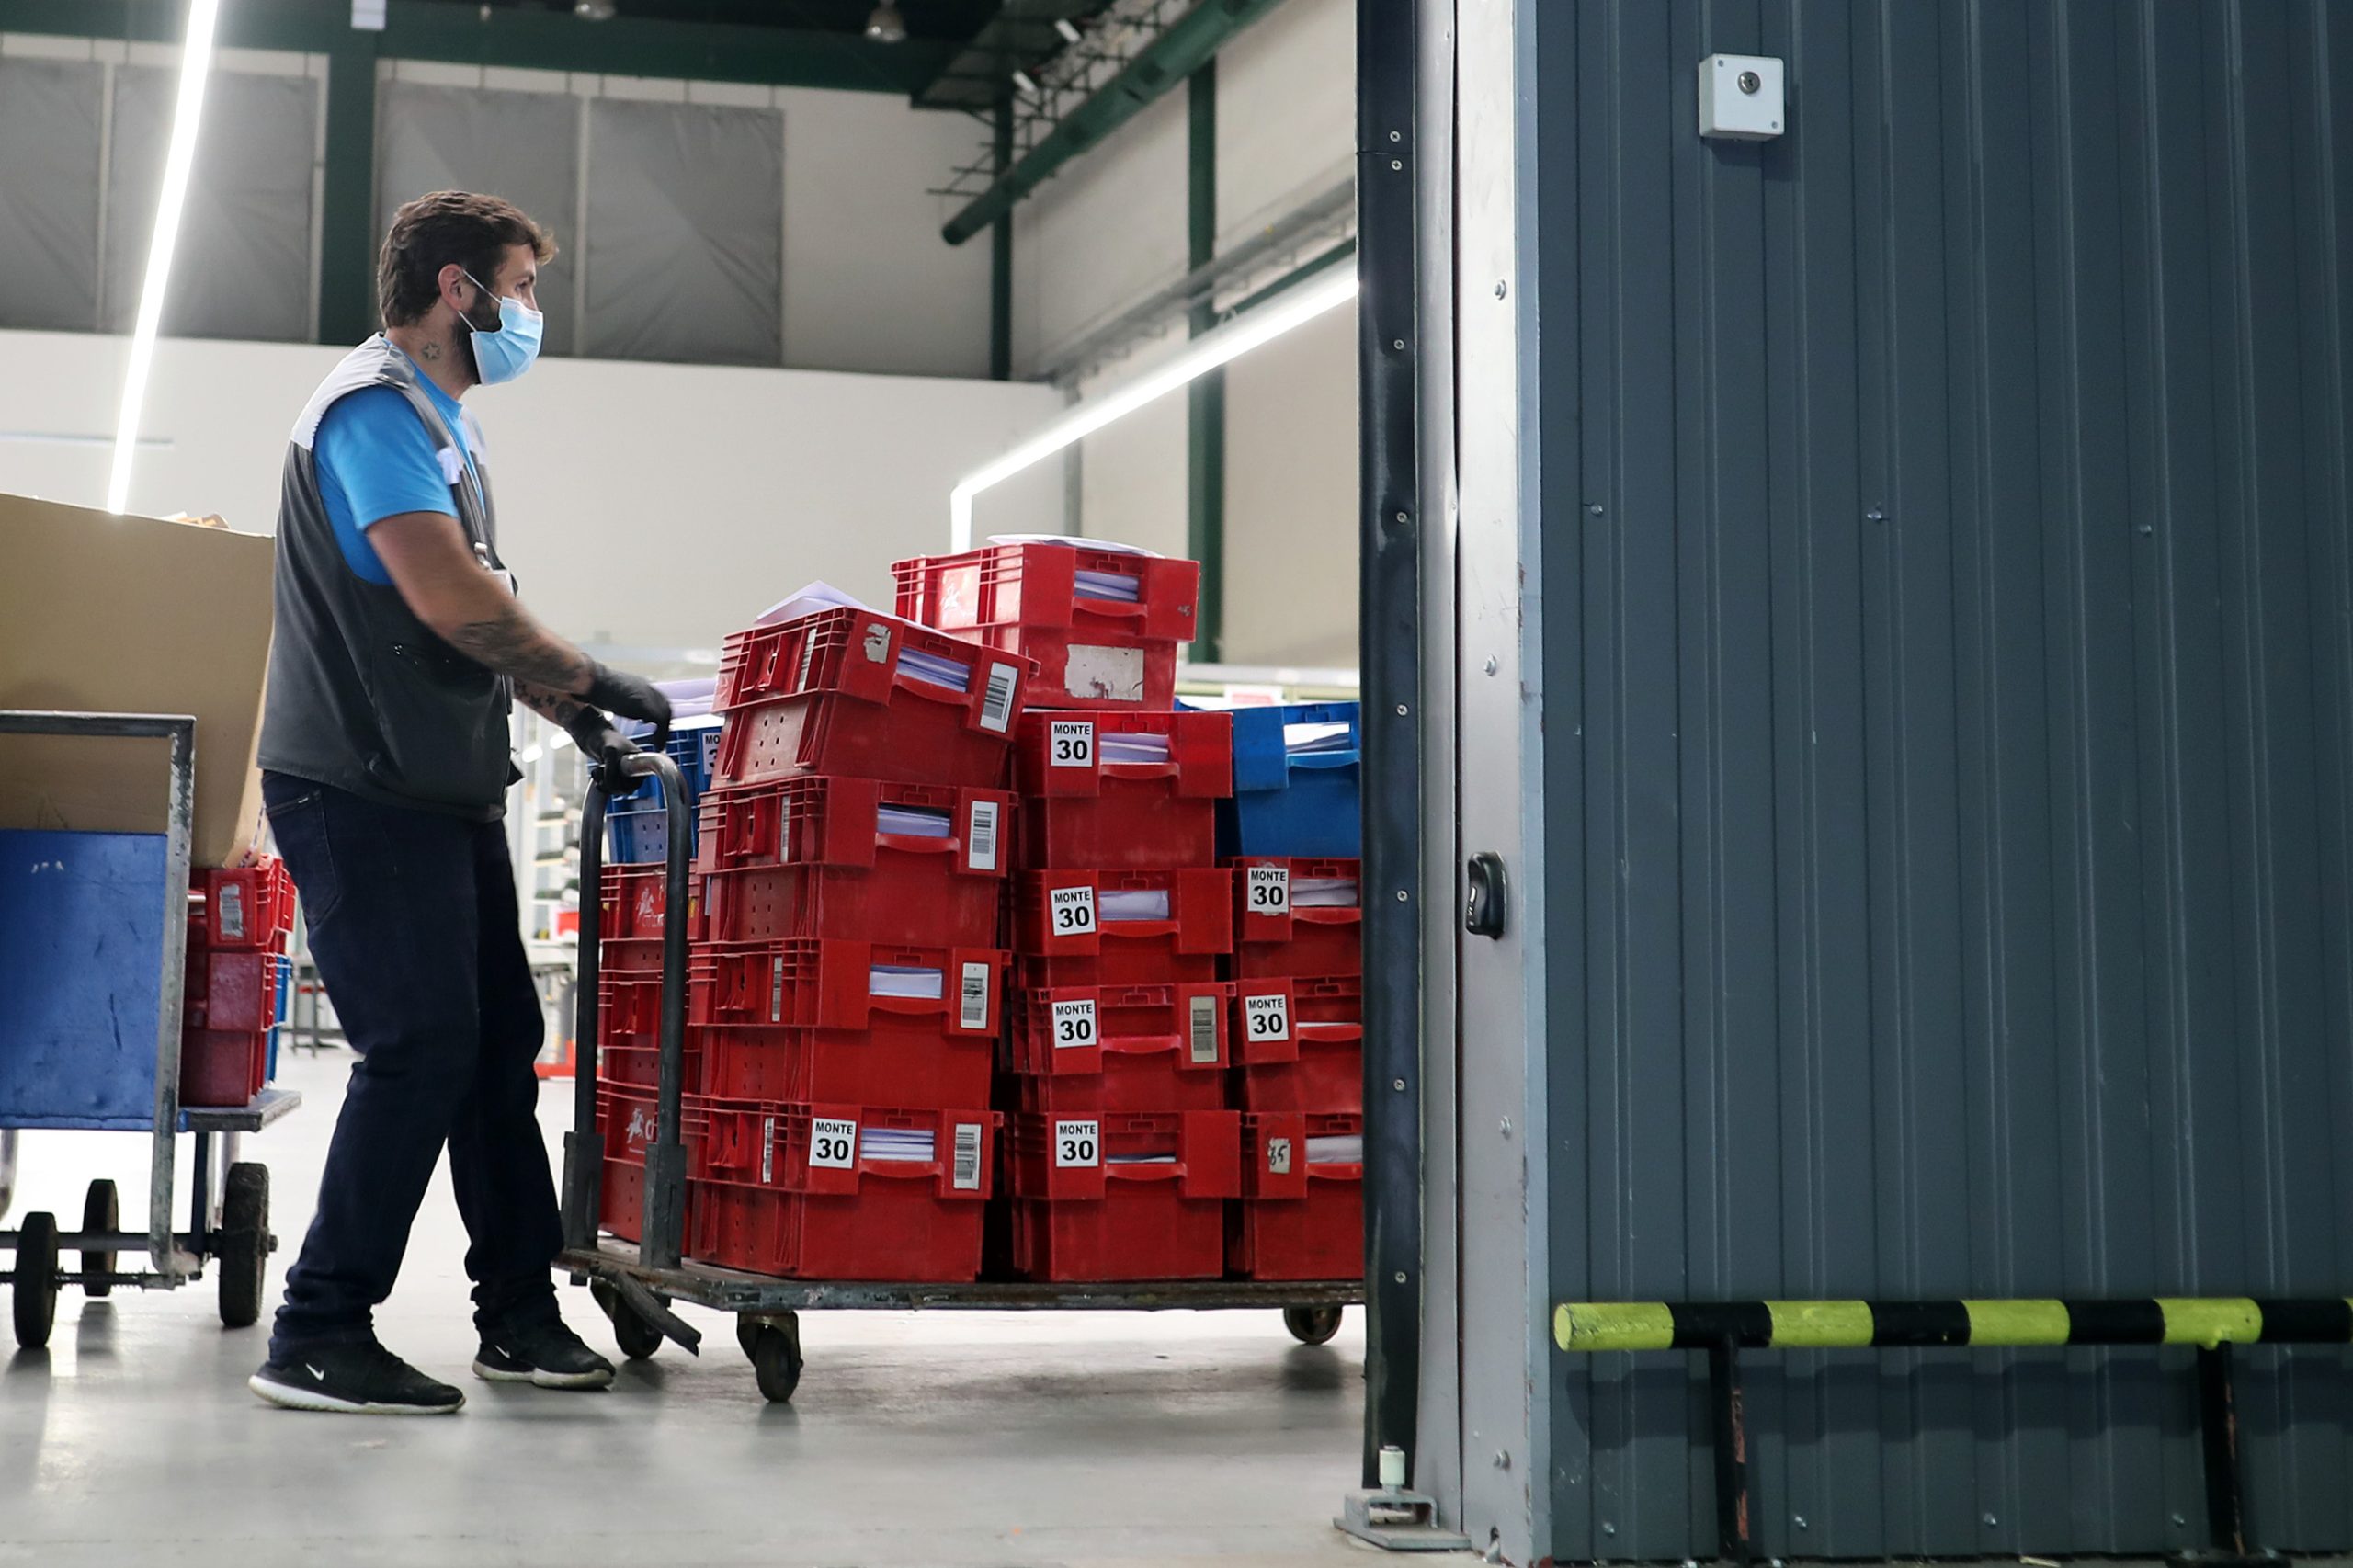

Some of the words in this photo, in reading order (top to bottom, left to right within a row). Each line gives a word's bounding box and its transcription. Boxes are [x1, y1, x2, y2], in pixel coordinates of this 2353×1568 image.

[1054, 724, 1090, 735] MONTE
[705, 734, 721, 744] MO
[1057, 739, 1087, 760] 30
[709, 749, 718, 767] 3
[1251, 870, 1286, 881] MONTE
[1054, 891, 1090, 903] MONTE
[1254, 885, 1284, 906] 30
[1058, 906, 1090, 928] 30
[1055, 1004, 1093, 1016] MONTE
[1248, 998, 1284, 1009] MONTE
[1060, 1019, 1091, 1040] 30
[1252, 1013, 1283, 1034] 30
[815, 1121, 854, 1135] MONTE
[1059, 1124, 1097, 1135] MONTE
[815, 1137, 849, 1161] 30
[1062, 1140, 1094, 1161] 30
